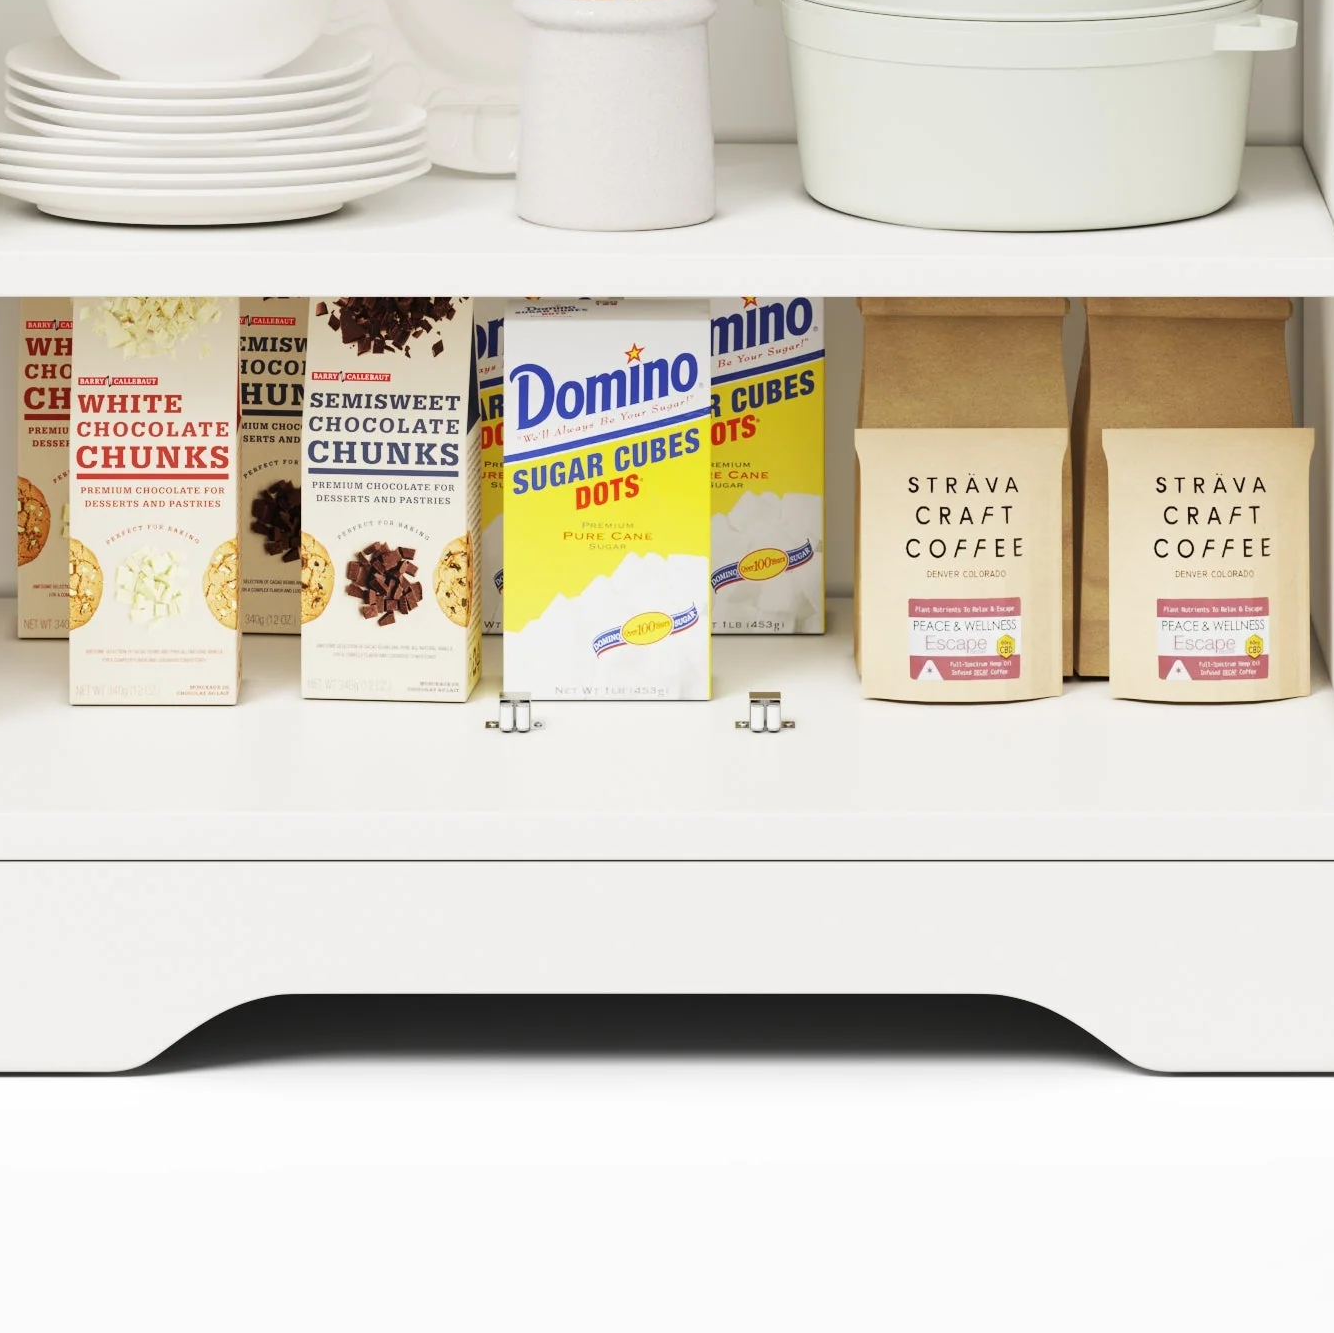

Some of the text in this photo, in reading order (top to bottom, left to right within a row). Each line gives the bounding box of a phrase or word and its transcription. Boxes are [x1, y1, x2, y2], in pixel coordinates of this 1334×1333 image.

[310, 392, 460, 411] SEMISWEET
[509, 352, 699, 431] Domino
[732, 369, 814, 414] CUBES
[78, 394, 182, 414] WHITE
[76, 421, 229, 438] CHOCOLATE
[308, 416, 460, 435] CHOCOLATE
[76, 445, 229, 469] CHUNKS
[308, 440, 459, 466] CHUNKS
[513, 428, 700, 495] SUGAR CUBES
[80, 486, 225, 494] PREMIUM CHOCOLATE FOR
[576, 474, 640, 510] DOTS
[908, 473, 1019, 494] STRÄVA
[1156, 473, 1266, 494] STRÄVA
[85, 500, 221, 508] DESSERTS AND PASTRIES
[916, 506, 1012, 525] CRAFT
[1163, 506, 1260, 525] CRAFT
[905, 537, 1023, 559] COFFEE
[1154, 537, 1271, 559] COFFEE
[927, 570, 1006, 578] DENVER COLORADO
[913, 619, 1017, 632] PEACE & WELLNESS
[925, 635, 987, 653] Escape
